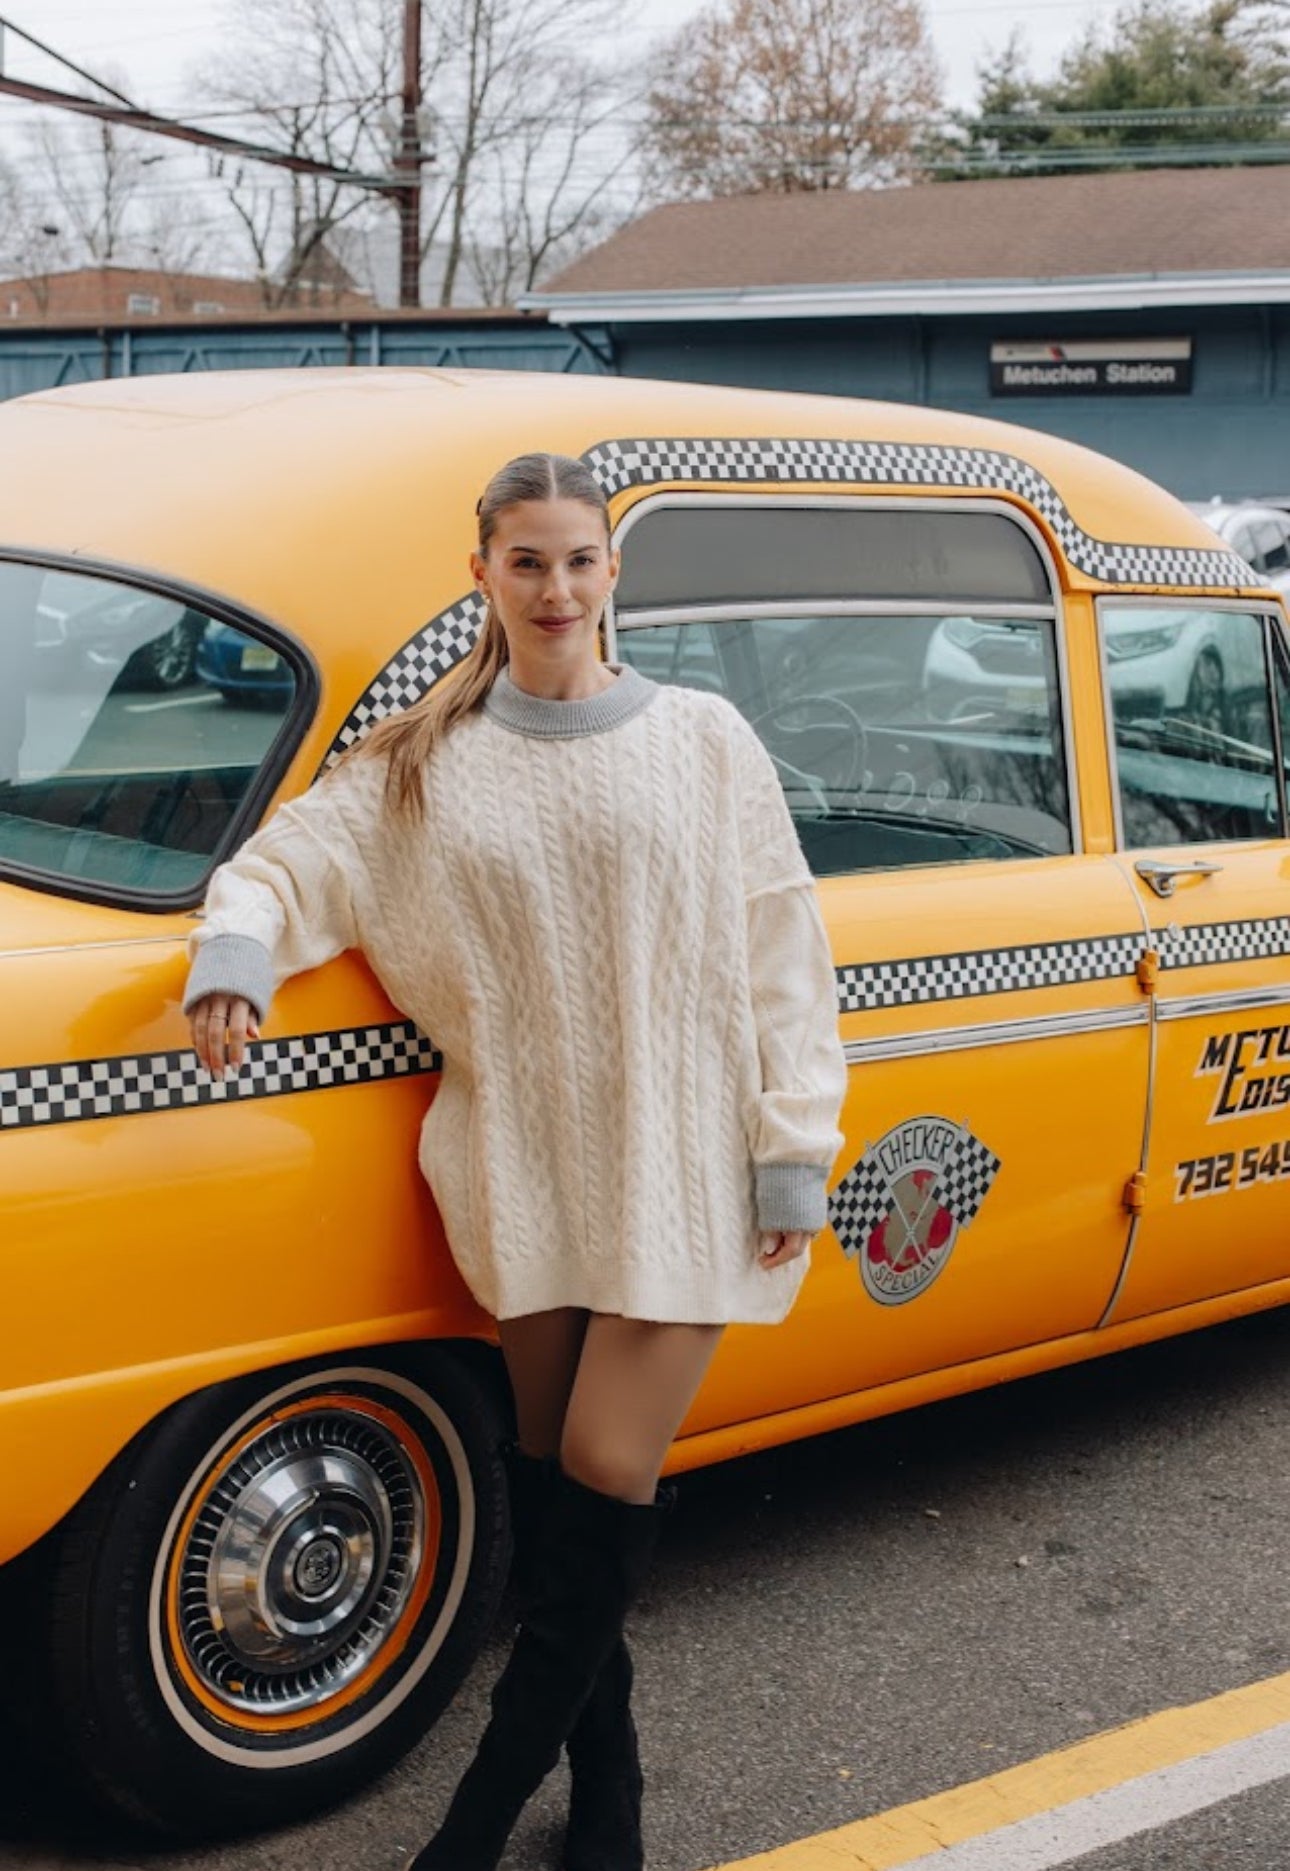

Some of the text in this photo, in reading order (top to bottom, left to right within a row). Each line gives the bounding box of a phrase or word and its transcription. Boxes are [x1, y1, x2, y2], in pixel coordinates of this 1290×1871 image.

[1003, 362, 1176, 385] Metuchen Station
[878, 1124, 955, 1176] CHECKER
[1175, 1152, 1235, 1200] 732
[873, 1255, 938, 1291] SPECIAL
